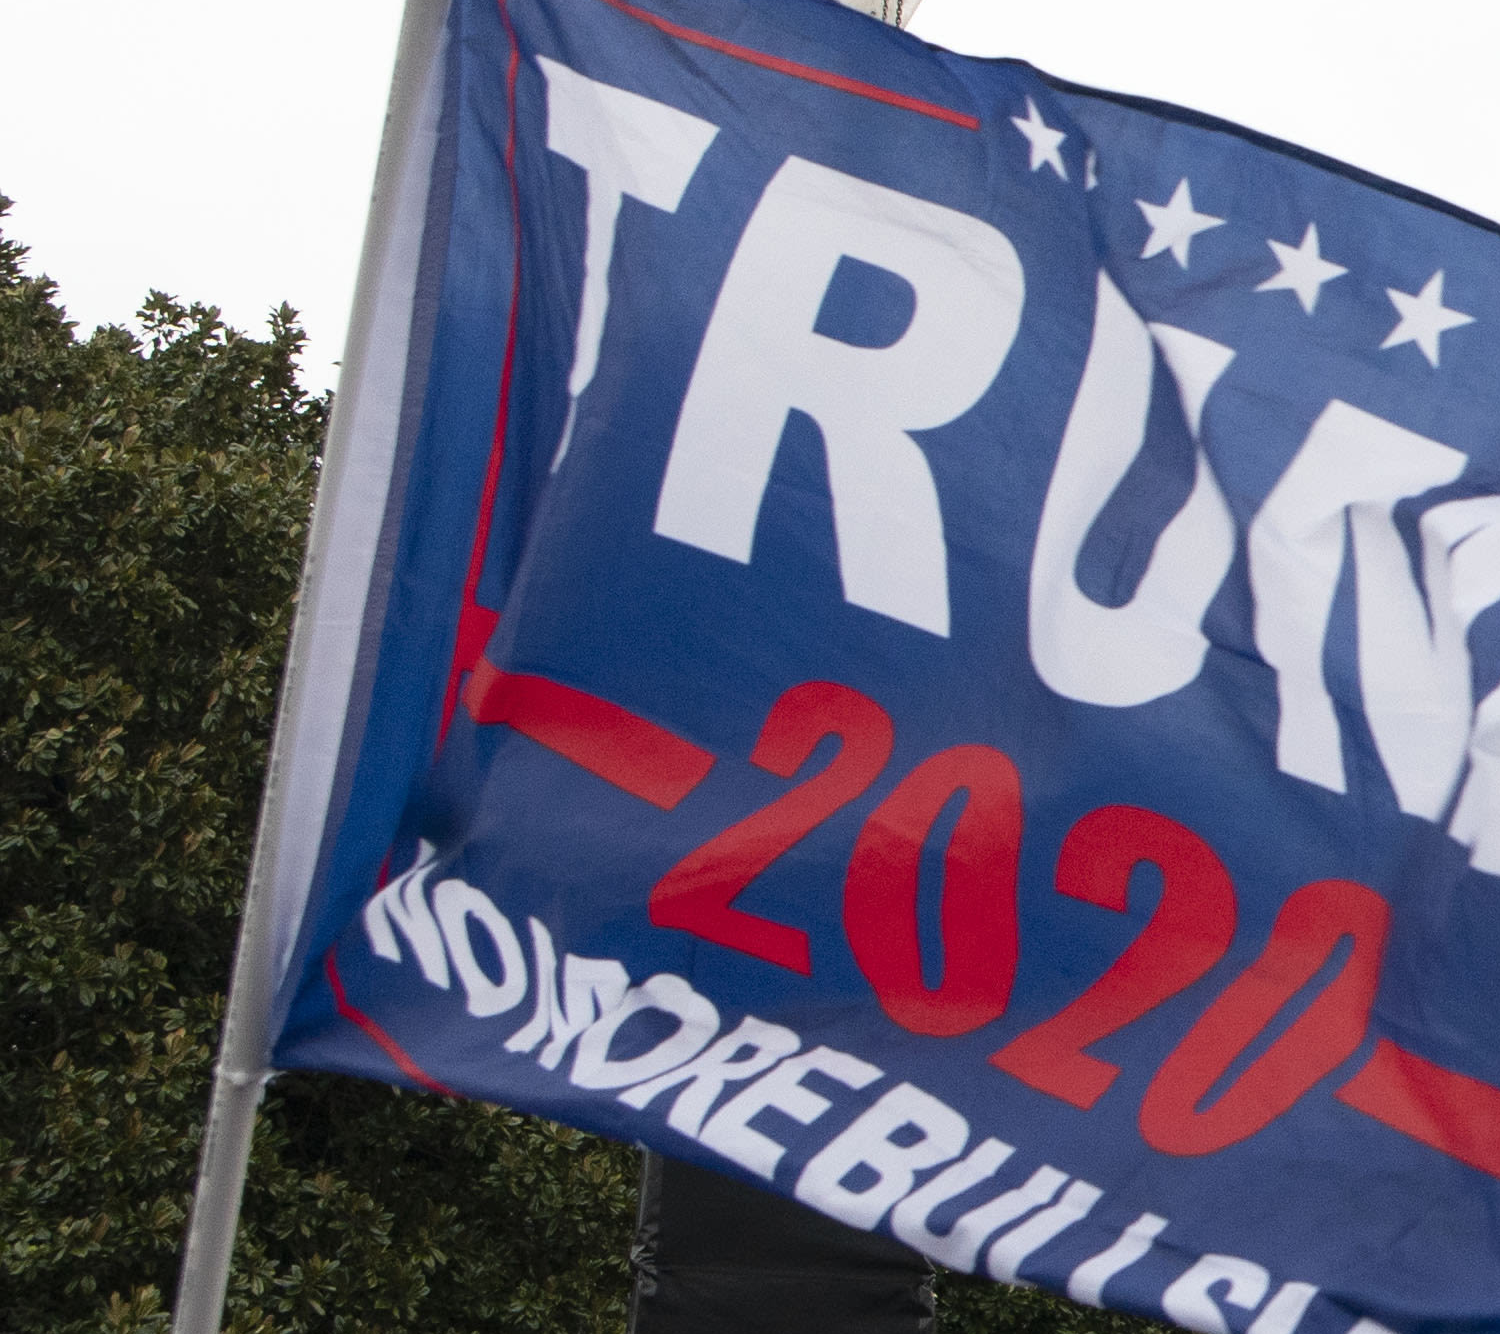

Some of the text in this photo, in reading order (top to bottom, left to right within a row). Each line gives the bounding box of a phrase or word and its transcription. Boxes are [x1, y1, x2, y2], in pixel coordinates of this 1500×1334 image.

[364, 837, 527, 1017] NO
[505, 915, 885, 1181] MORE
[648, 679, 1390, 1157] 2020
